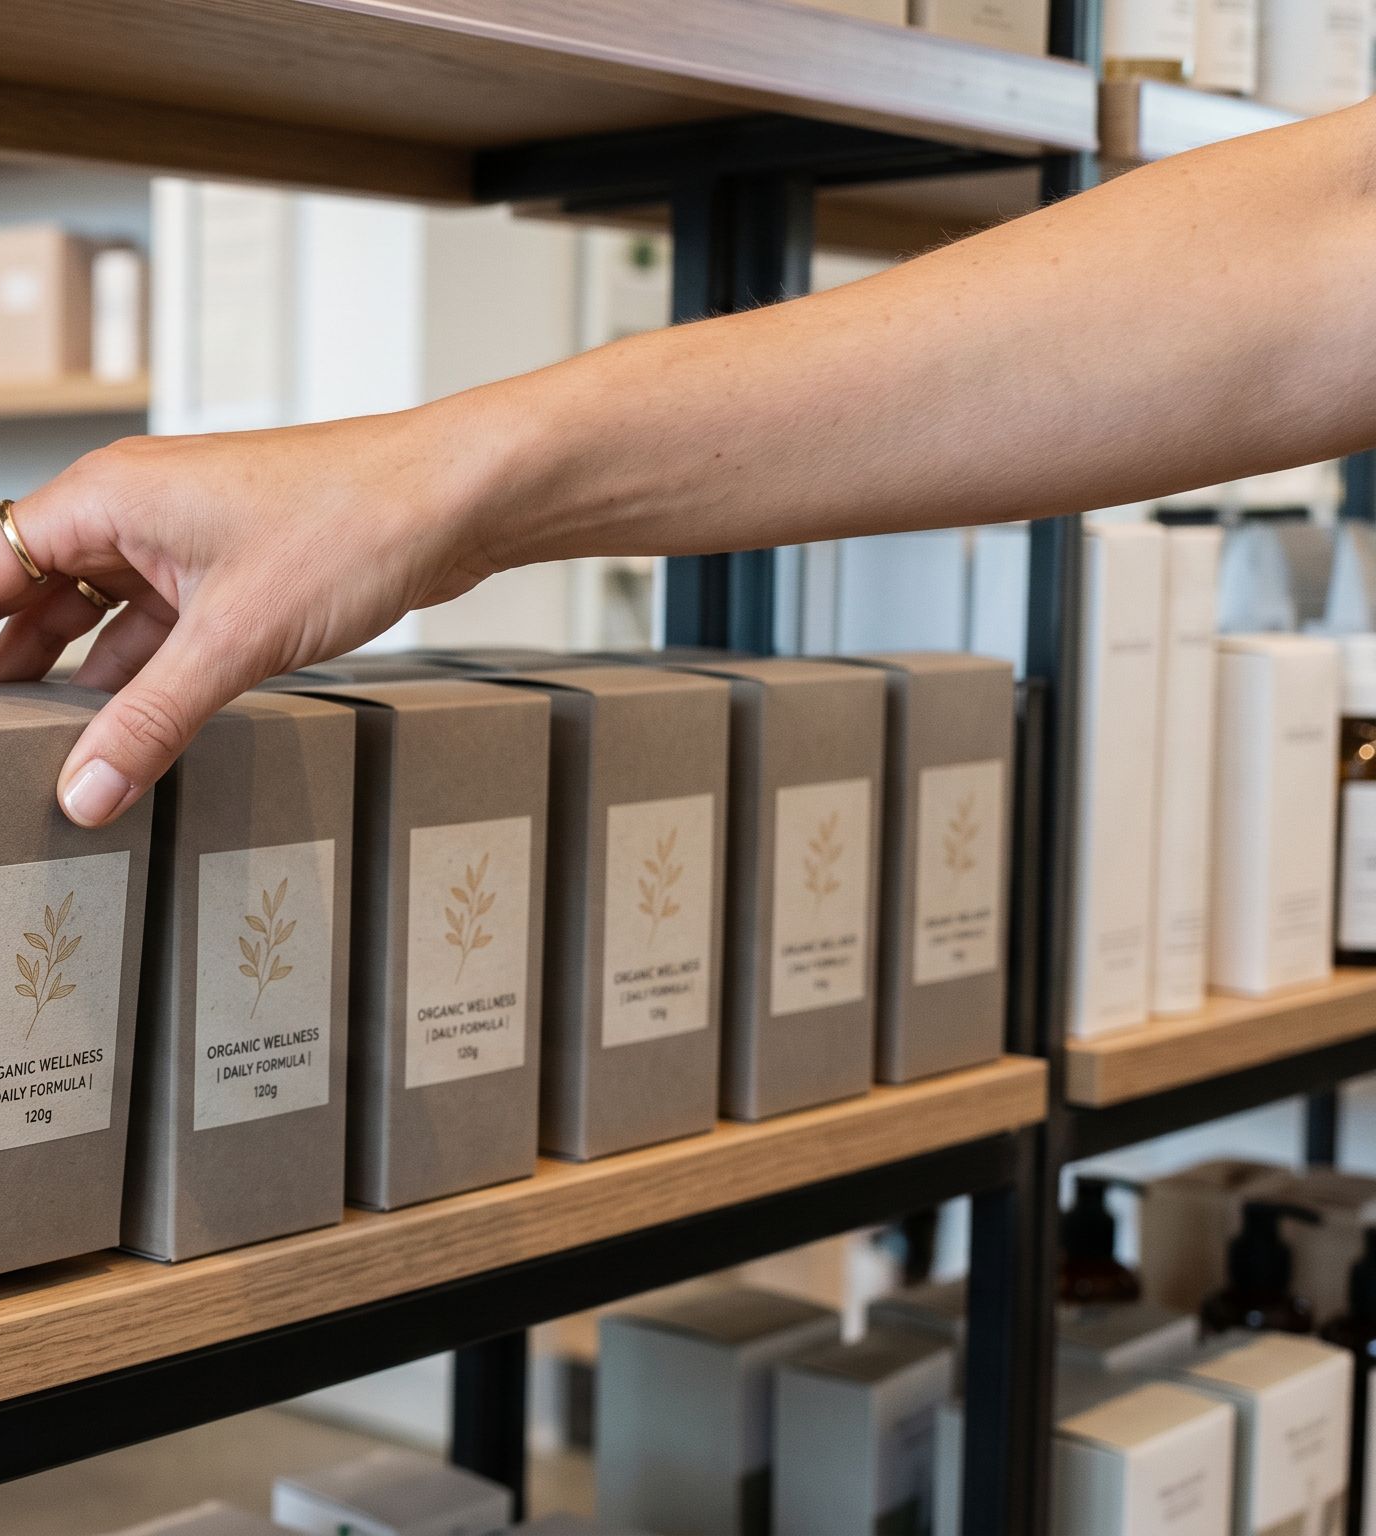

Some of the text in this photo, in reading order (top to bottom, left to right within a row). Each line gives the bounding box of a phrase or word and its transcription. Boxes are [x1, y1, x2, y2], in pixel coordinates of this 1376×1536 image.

[207, 1027, 320, 1060] ORGANIC WELLNESS
[39, 1048, 103, 1072] WELLNESS
[223, 1062, 254, 1080] DAILY
[256, 1053, 306, 1074] FORMULA
[29, 1075, 86, 1098] FORMULA
[254, 1083, 278, 1099] 120g
[25, 1108, 52, 1124] 120g
